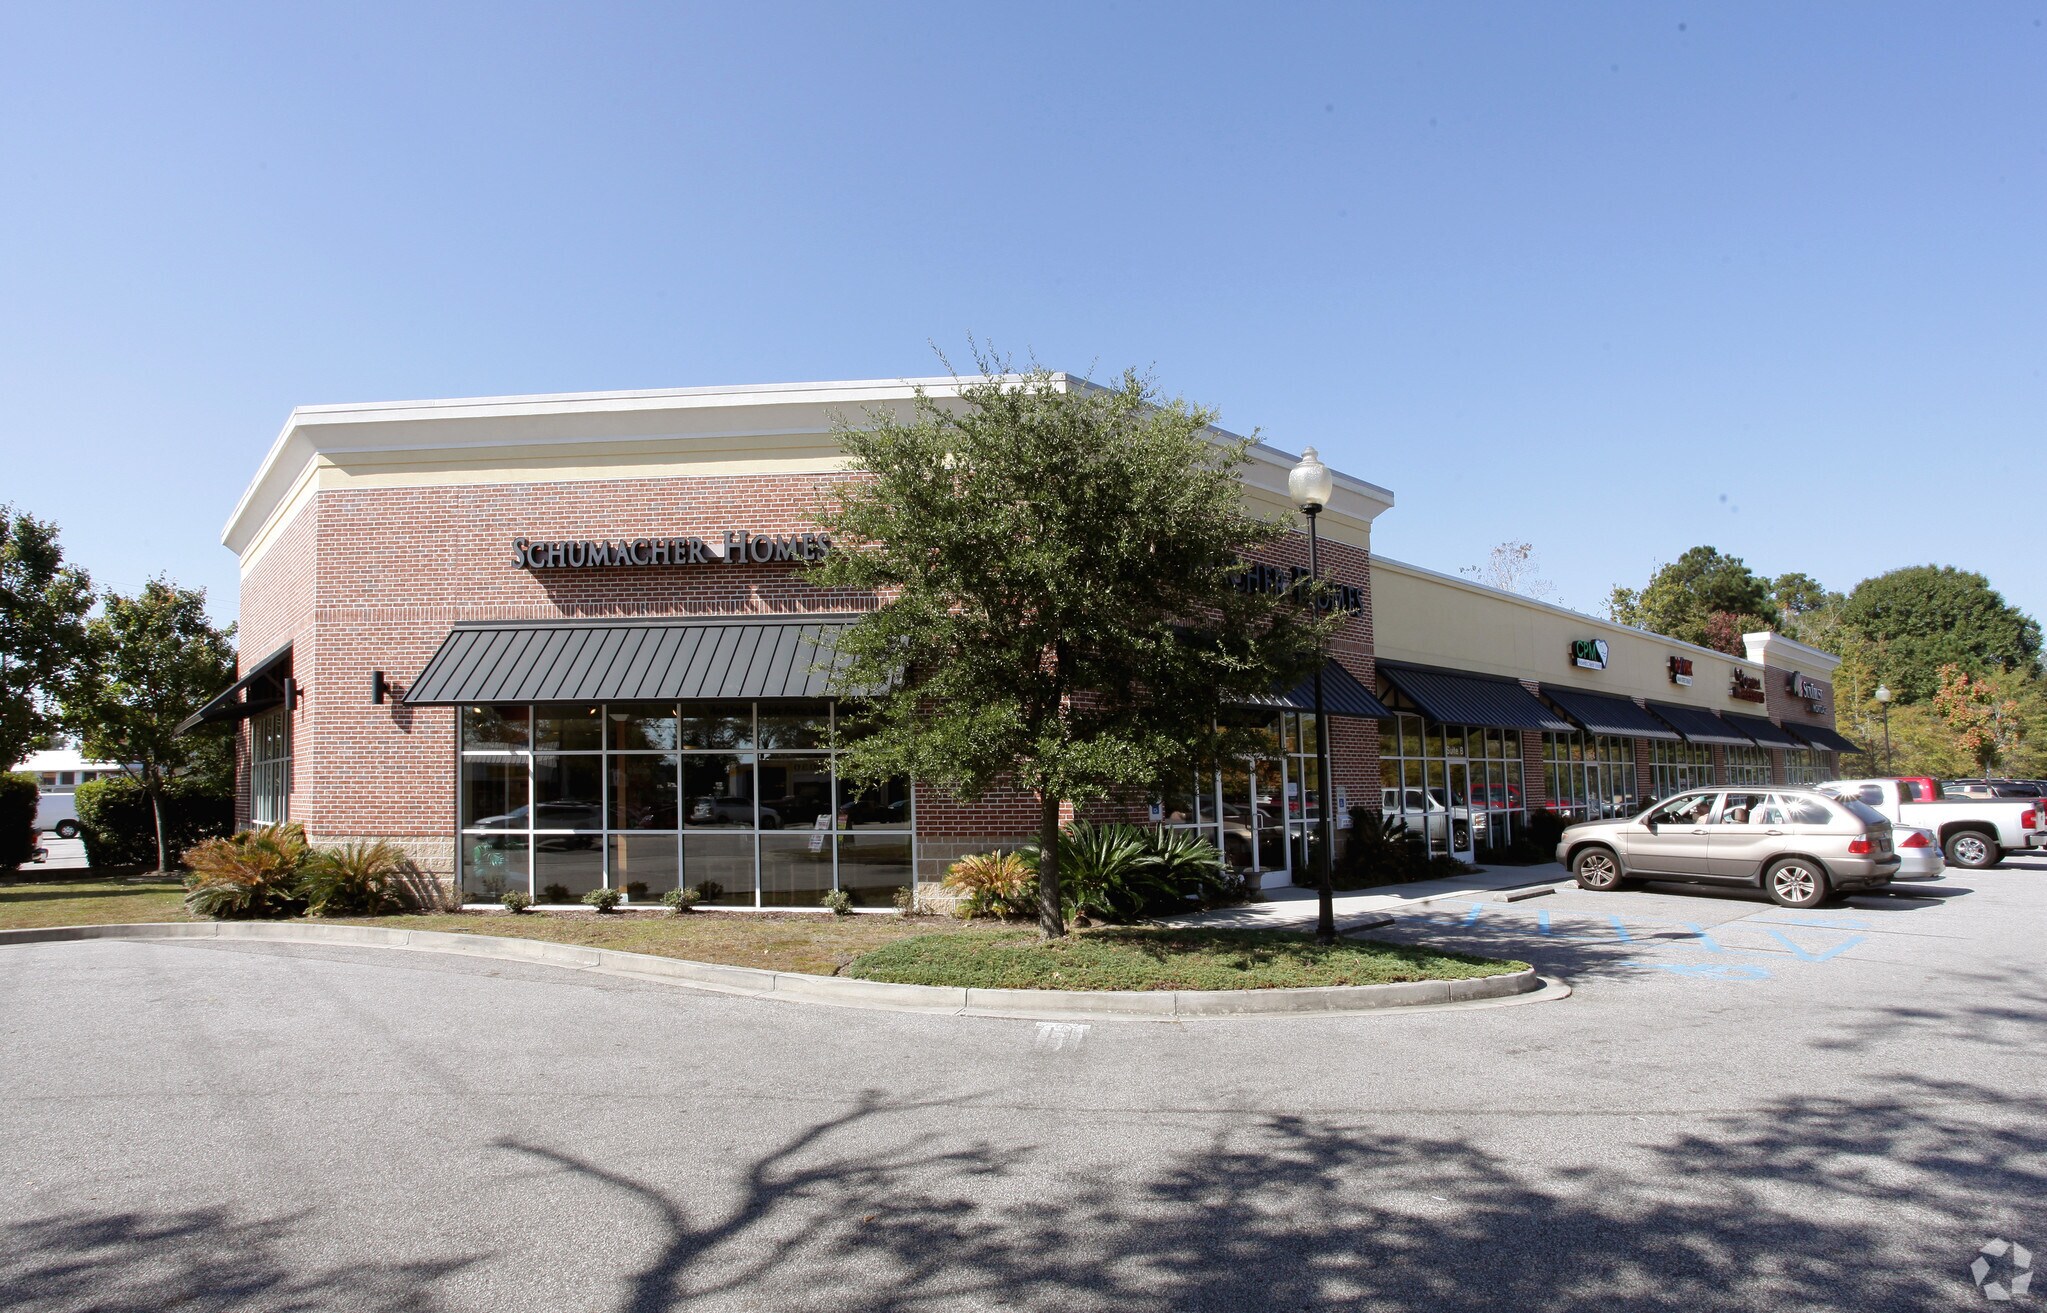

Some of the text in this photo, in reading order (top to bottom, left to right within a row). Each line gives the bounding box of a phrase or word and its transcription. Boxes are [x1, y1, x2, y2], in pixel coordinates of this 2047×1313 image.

[511, 530, 833, 569] SCHUMACHER HOMES
[1576, 639, 1598, 661] CPM
[1446, 745, 1459, 755] Suite
